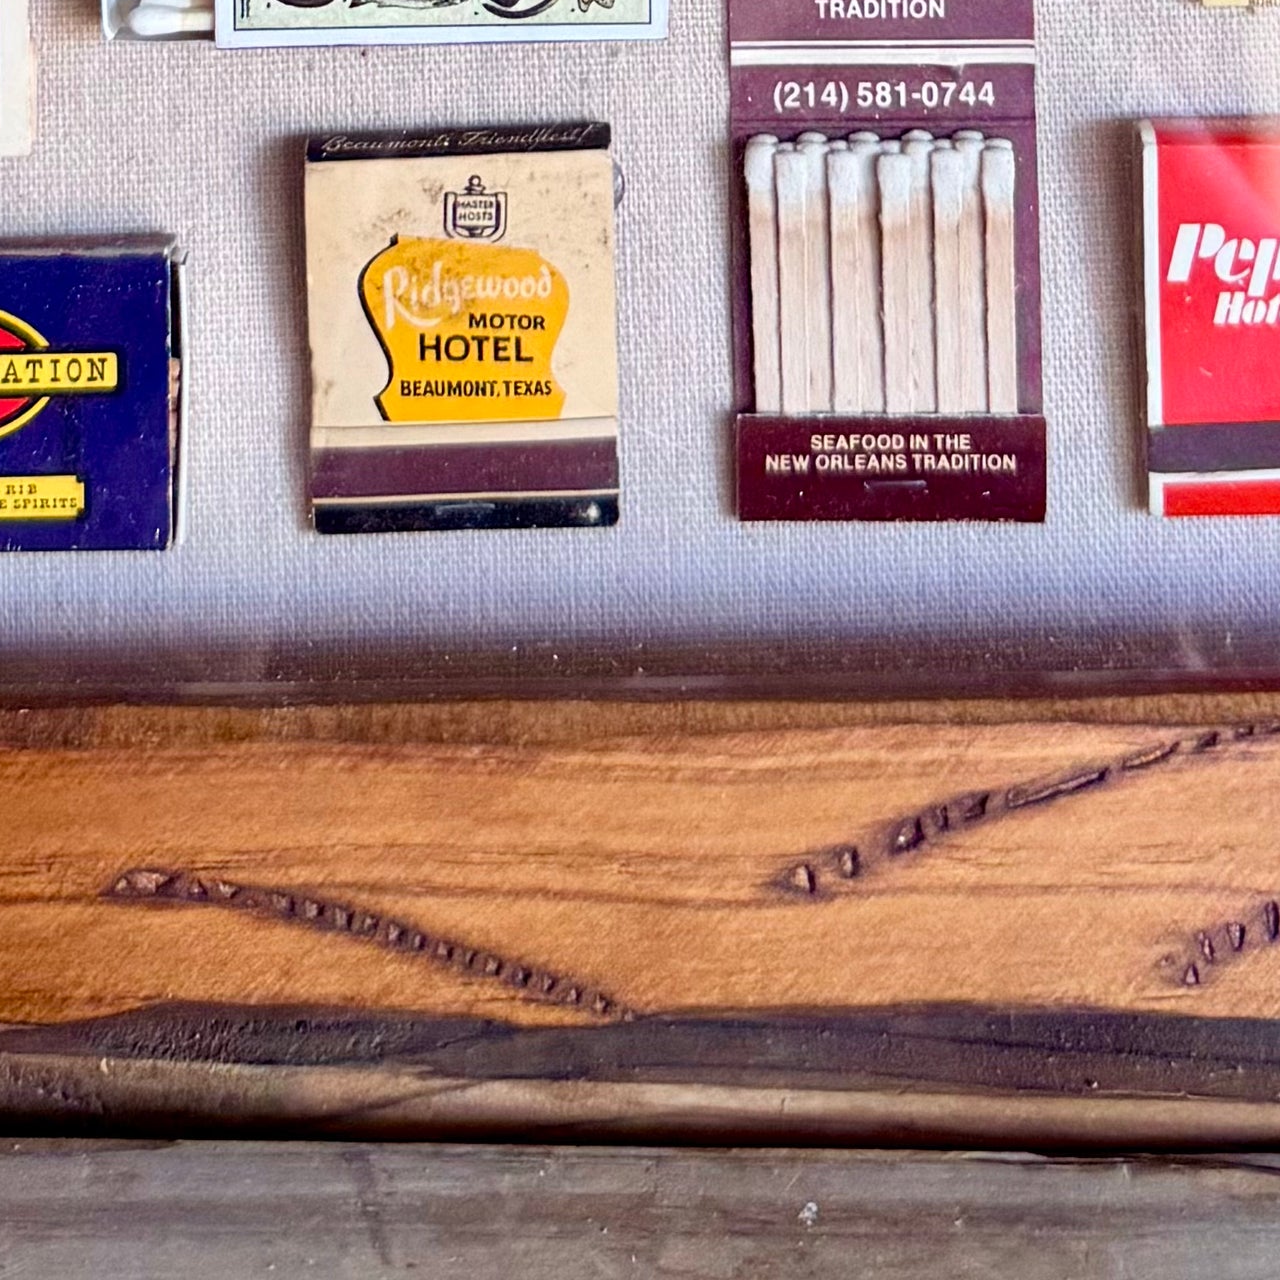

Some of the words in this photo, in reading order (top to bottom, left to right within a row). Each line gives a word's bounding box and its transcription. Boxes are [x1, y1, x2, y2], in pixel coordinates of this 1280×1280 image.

[773, 81, 848, 112] (214)
[857, 81, 994, 107] 581-0744
[383, 260, 552, 329] Ridgewood
[468, 313, 545, 331] MOTOR
[420, 334, 533, 362] HOTEL
[400, 380, 500, 398] BEAUMONT,
[503, 380, 551, 397] TEXAS
[811, 435, 904, 450] SEAFOOD
[910, 434, 928, 450] IN
[935, 434, 970, 450] THE
[766, 455, 809, 470] NEW
[816, 455, 906, 469] ORLEANS
[913, 454, 1015, 470] TRADITION
[6, 484, 37, 495] RIB
[13, 497, 77, 509] SPIRITS
